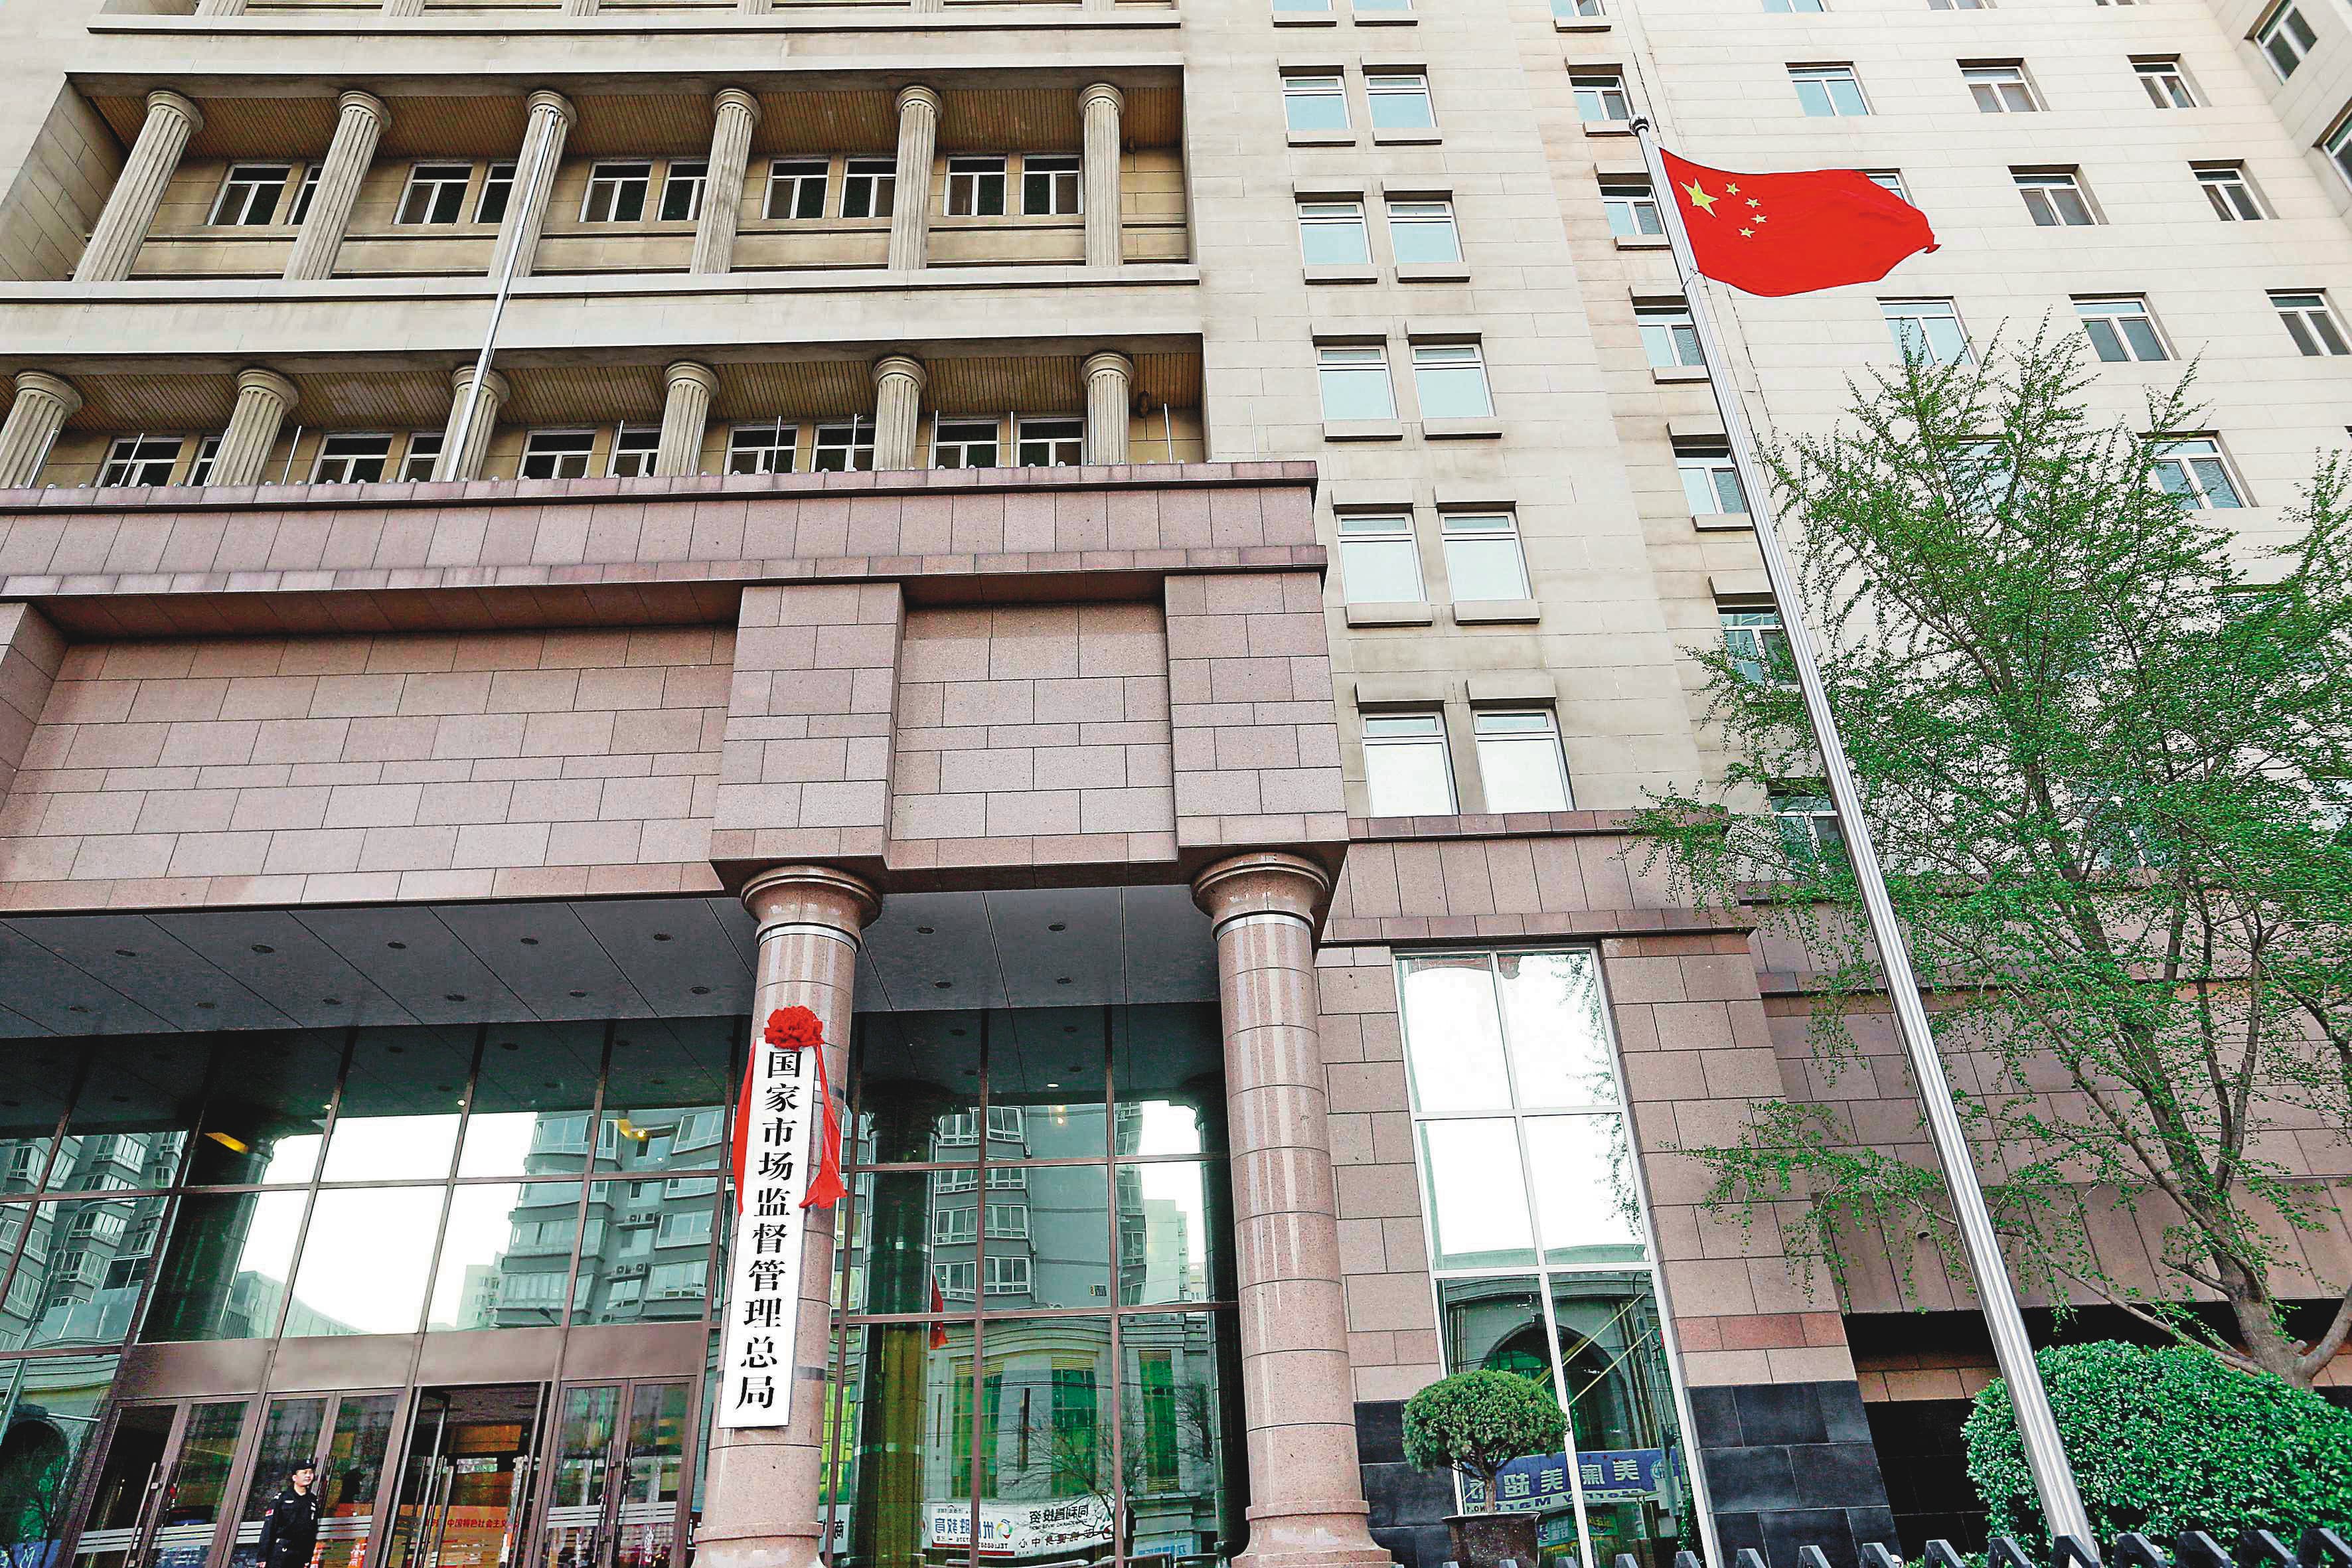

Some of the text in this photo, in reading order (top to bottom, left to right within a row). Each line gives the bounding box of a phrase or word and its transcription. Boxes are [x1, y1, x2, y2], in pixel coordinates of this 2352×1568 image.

[736, 1050, 803, 1410] 国家市场监督管理总局
